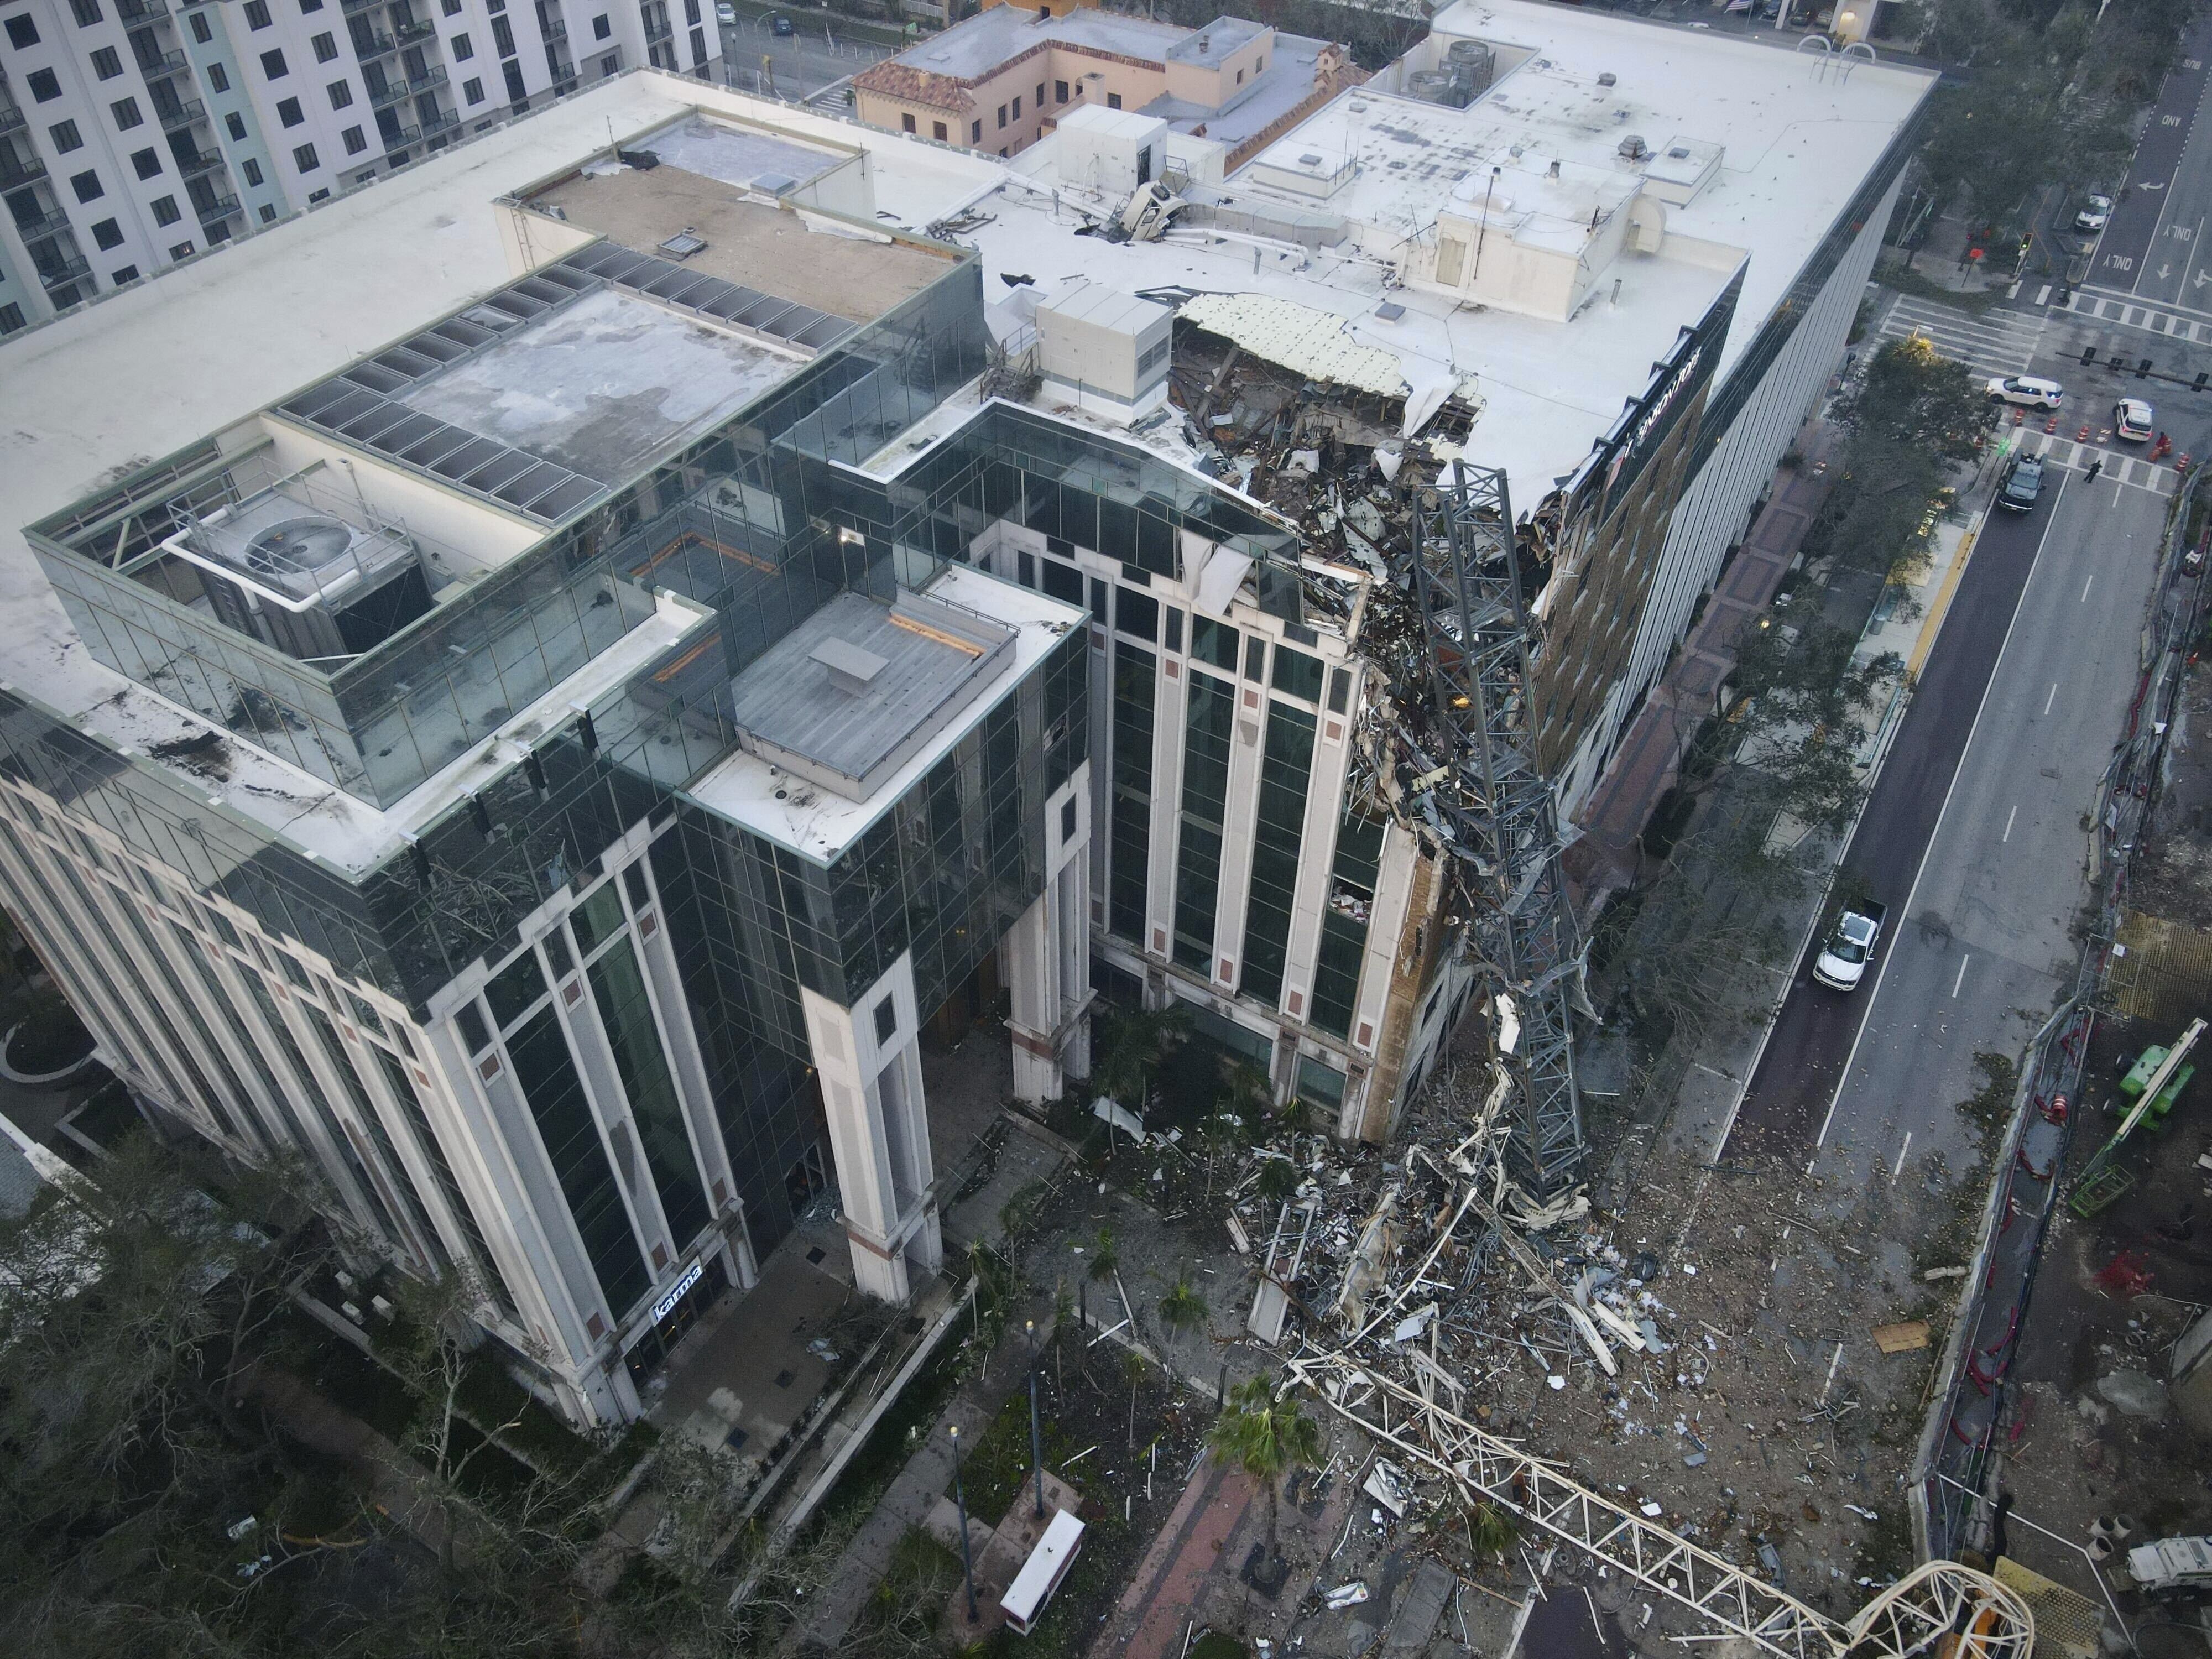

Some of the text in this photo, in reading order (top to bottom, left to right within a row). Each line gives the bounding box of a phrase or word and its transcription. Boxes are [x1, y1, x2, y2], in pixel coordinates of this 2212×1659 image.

[2162, 114, 2182, 127] AND
[2163, 224, 2191, 241] ONLY
[2103, 253, 2133, 271] ONLY
[653, 1265, 703, 1321] karma
